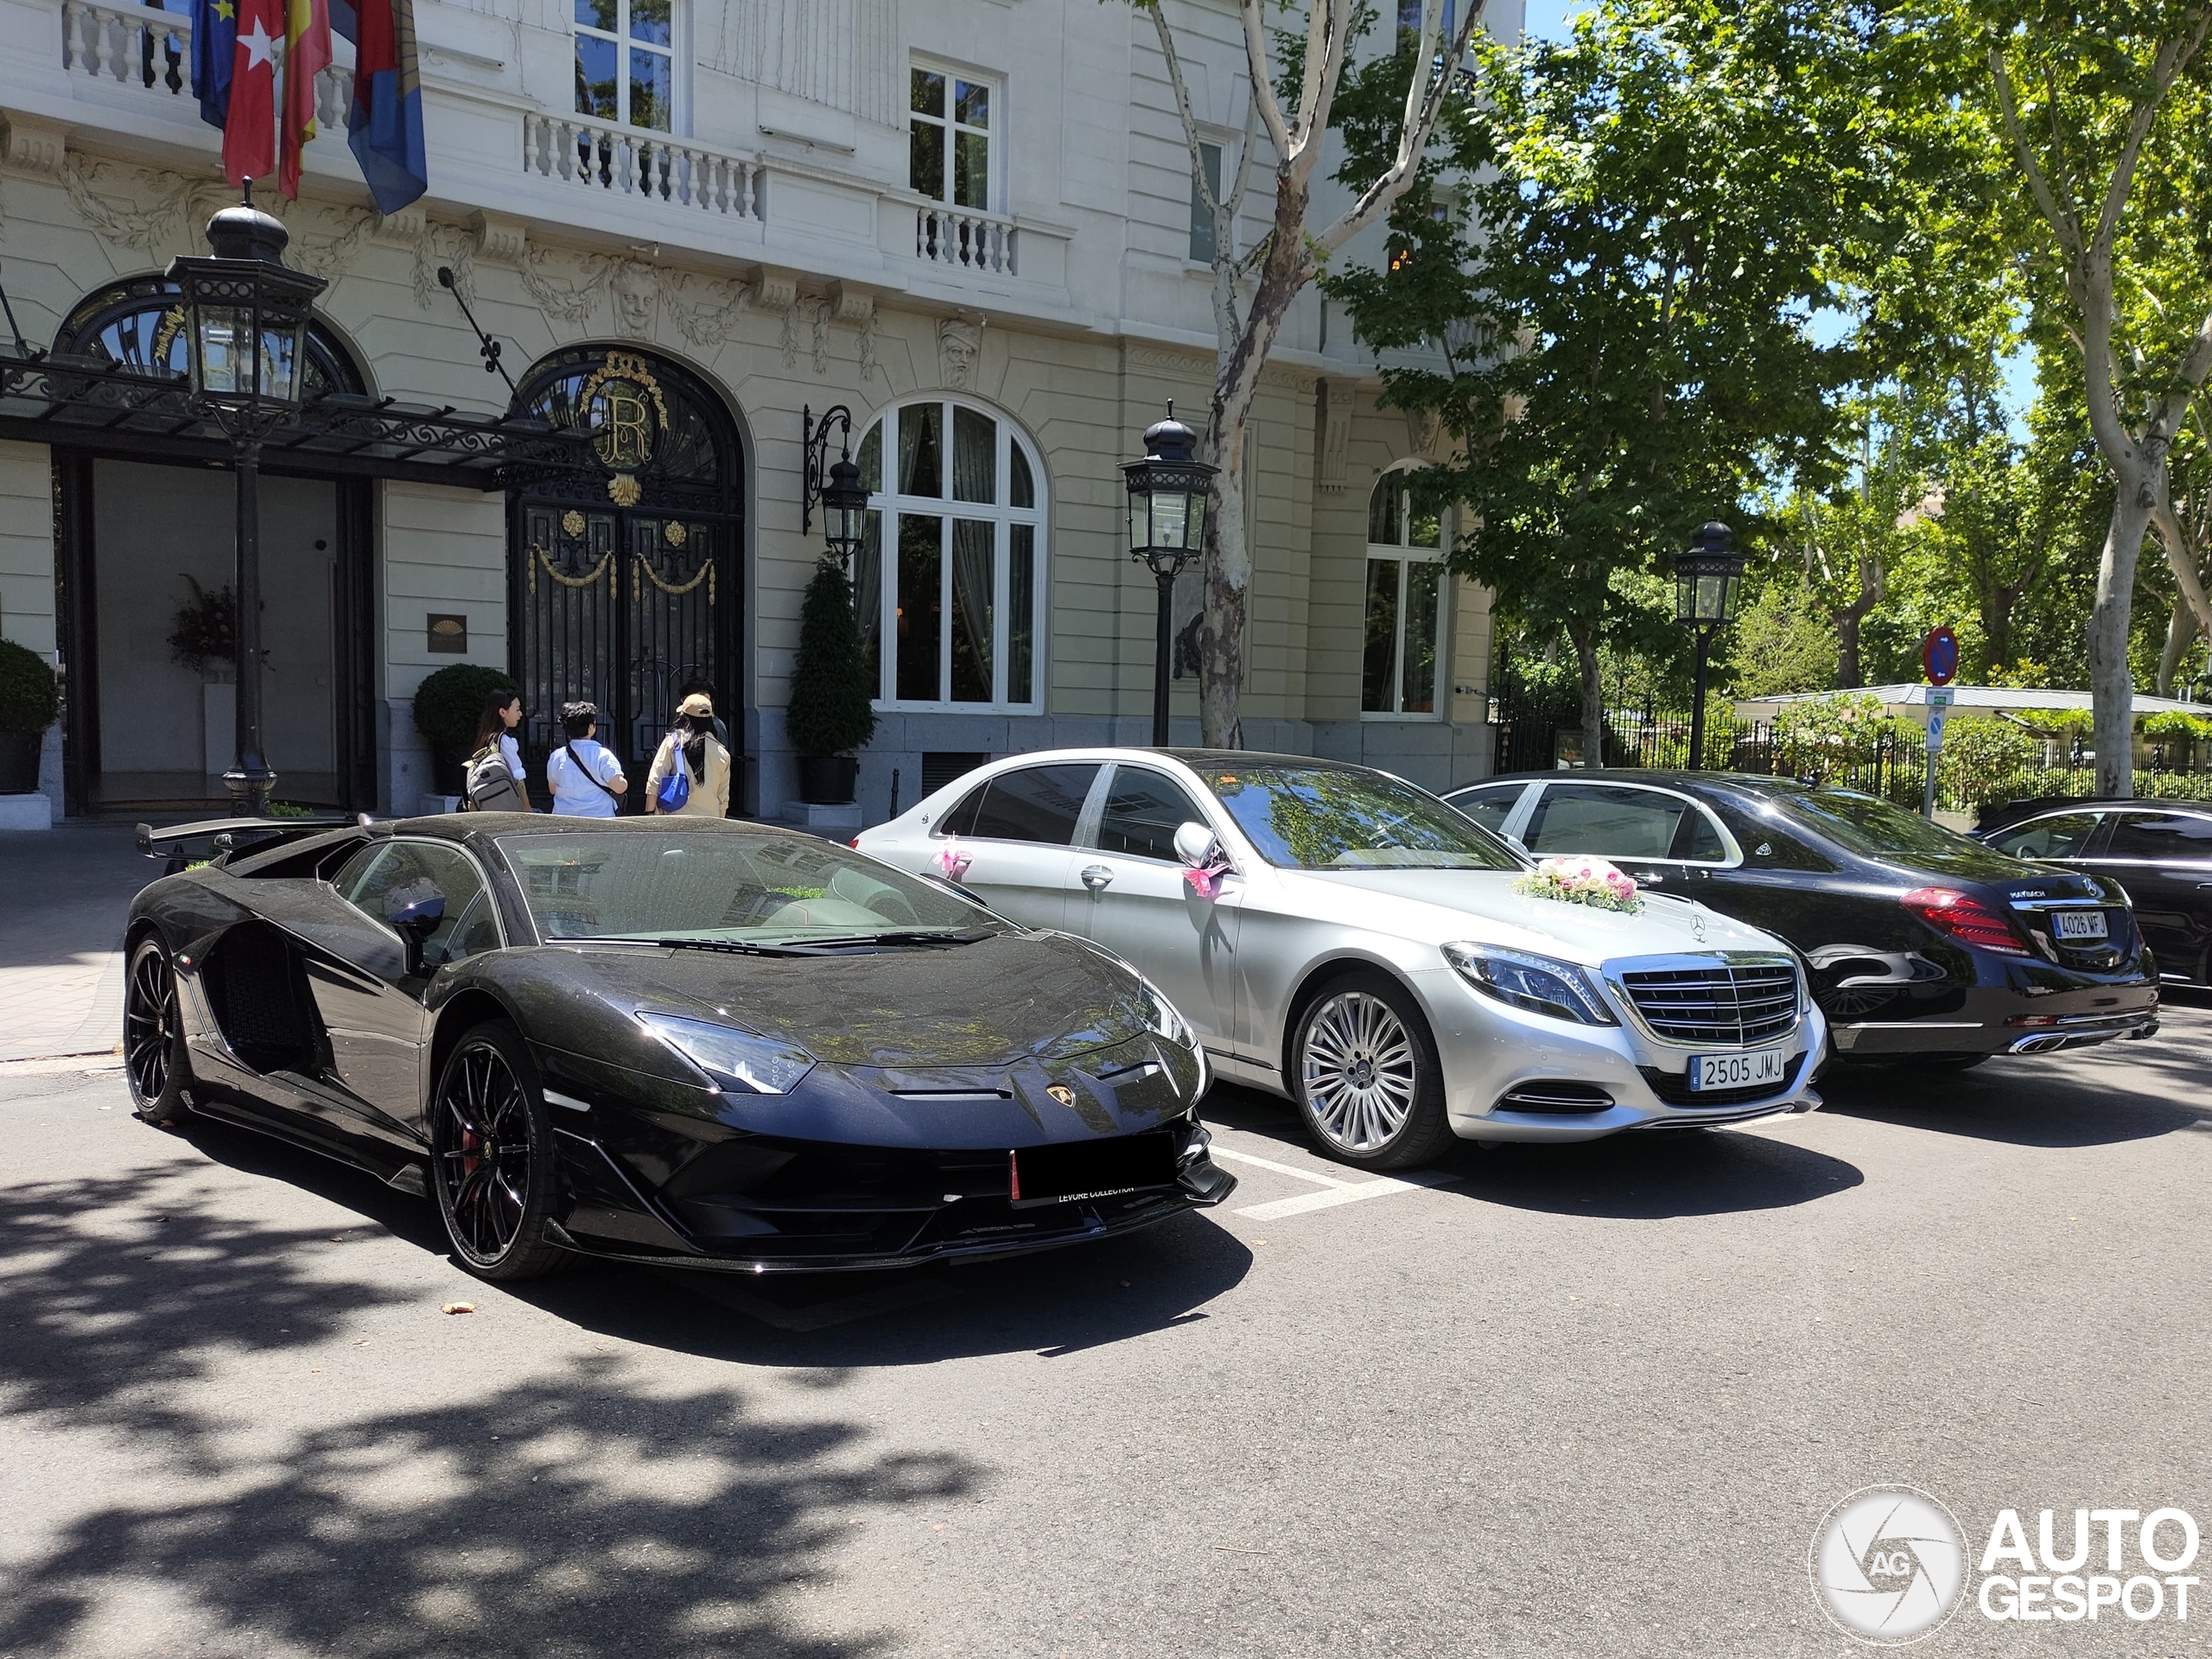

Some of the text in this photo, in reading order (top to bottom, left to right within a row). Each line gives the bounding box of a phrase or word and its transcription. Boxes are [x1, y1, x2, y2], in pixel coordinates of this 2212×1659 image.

[2009, 890, 2046, 899] MAYBACH
[2062, 916, 2088, 935] 4026
[1705, 1052, 1782, 1085] 2505 JMJ
